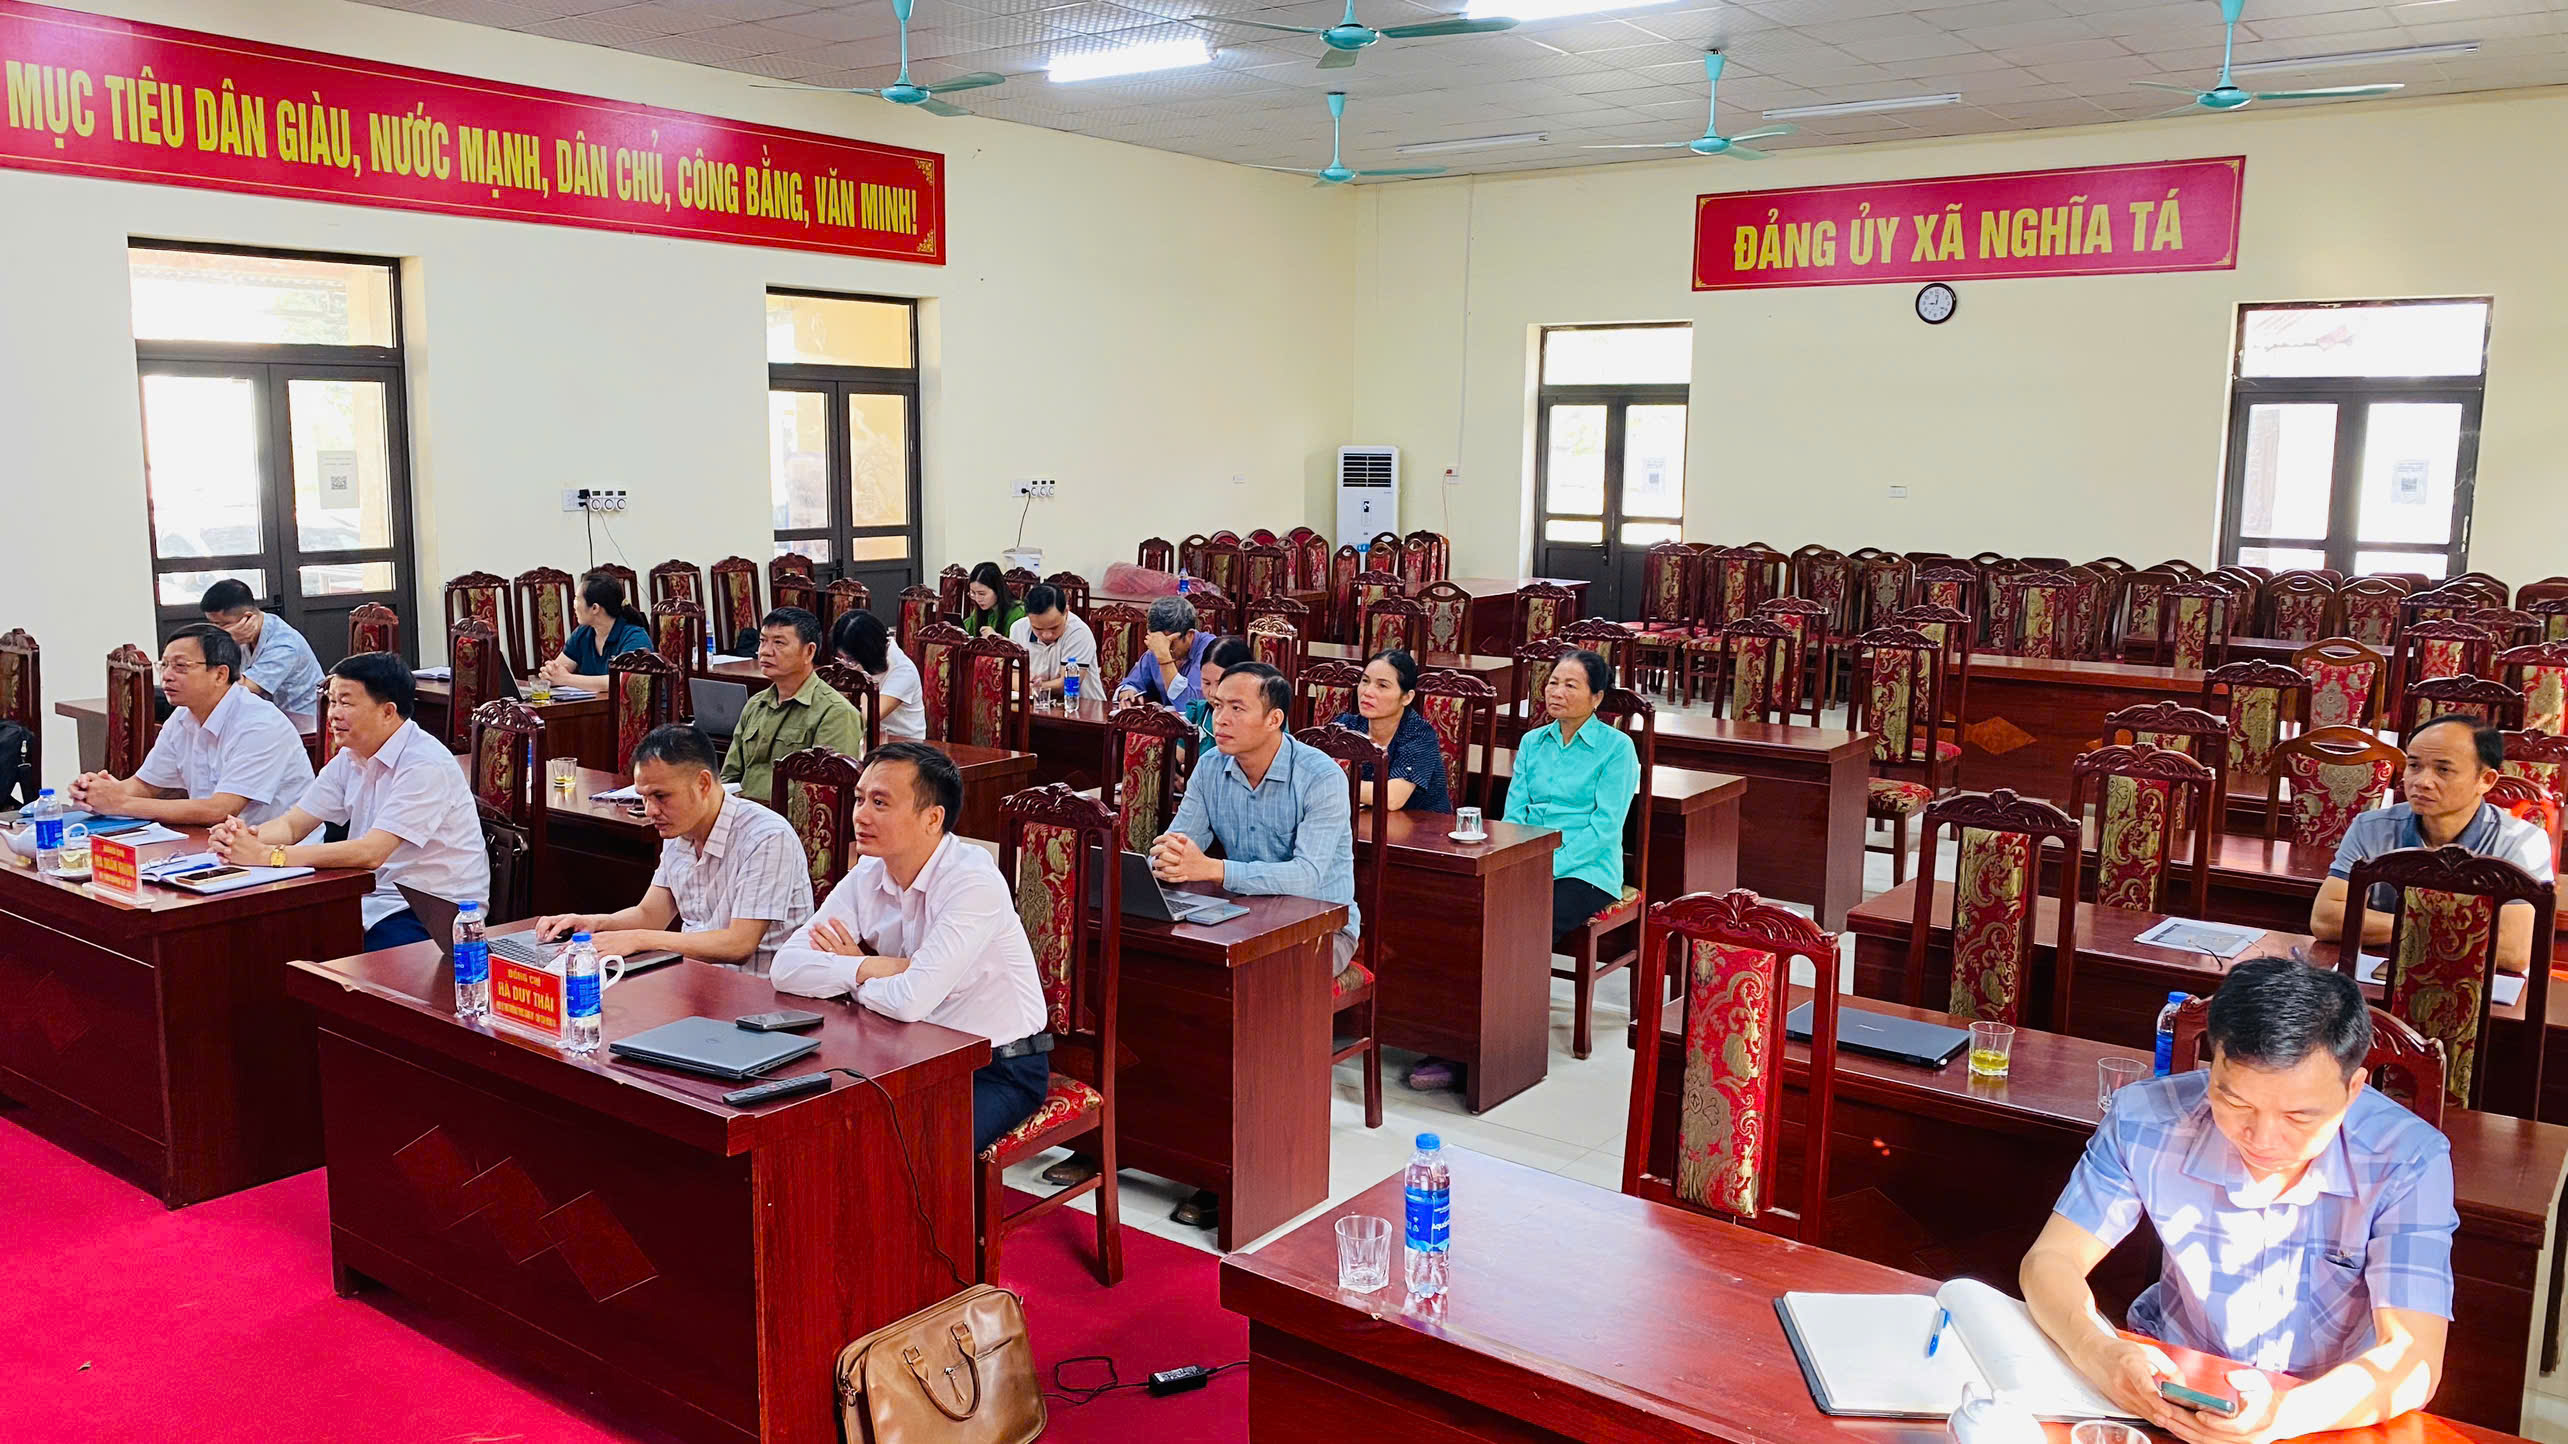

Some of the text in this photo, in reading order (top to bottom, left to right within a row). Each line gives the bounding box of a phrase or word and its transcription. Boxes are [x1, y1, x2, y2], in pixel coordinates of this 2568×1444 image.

[5, 60, 918, 235] MỤC TIÊU DÂN GIÀU, NƯỚC MẠNH, DÂN CHỦ, CÔNG BẰNG, VĂN MINH!
[1733, 187, 2183, 271] ĐẢNG ỦY XÃ NGHĨA TÁ
[512, 985, 531, 1005] DUY
[533, 991, 554, 1012] THÁI
